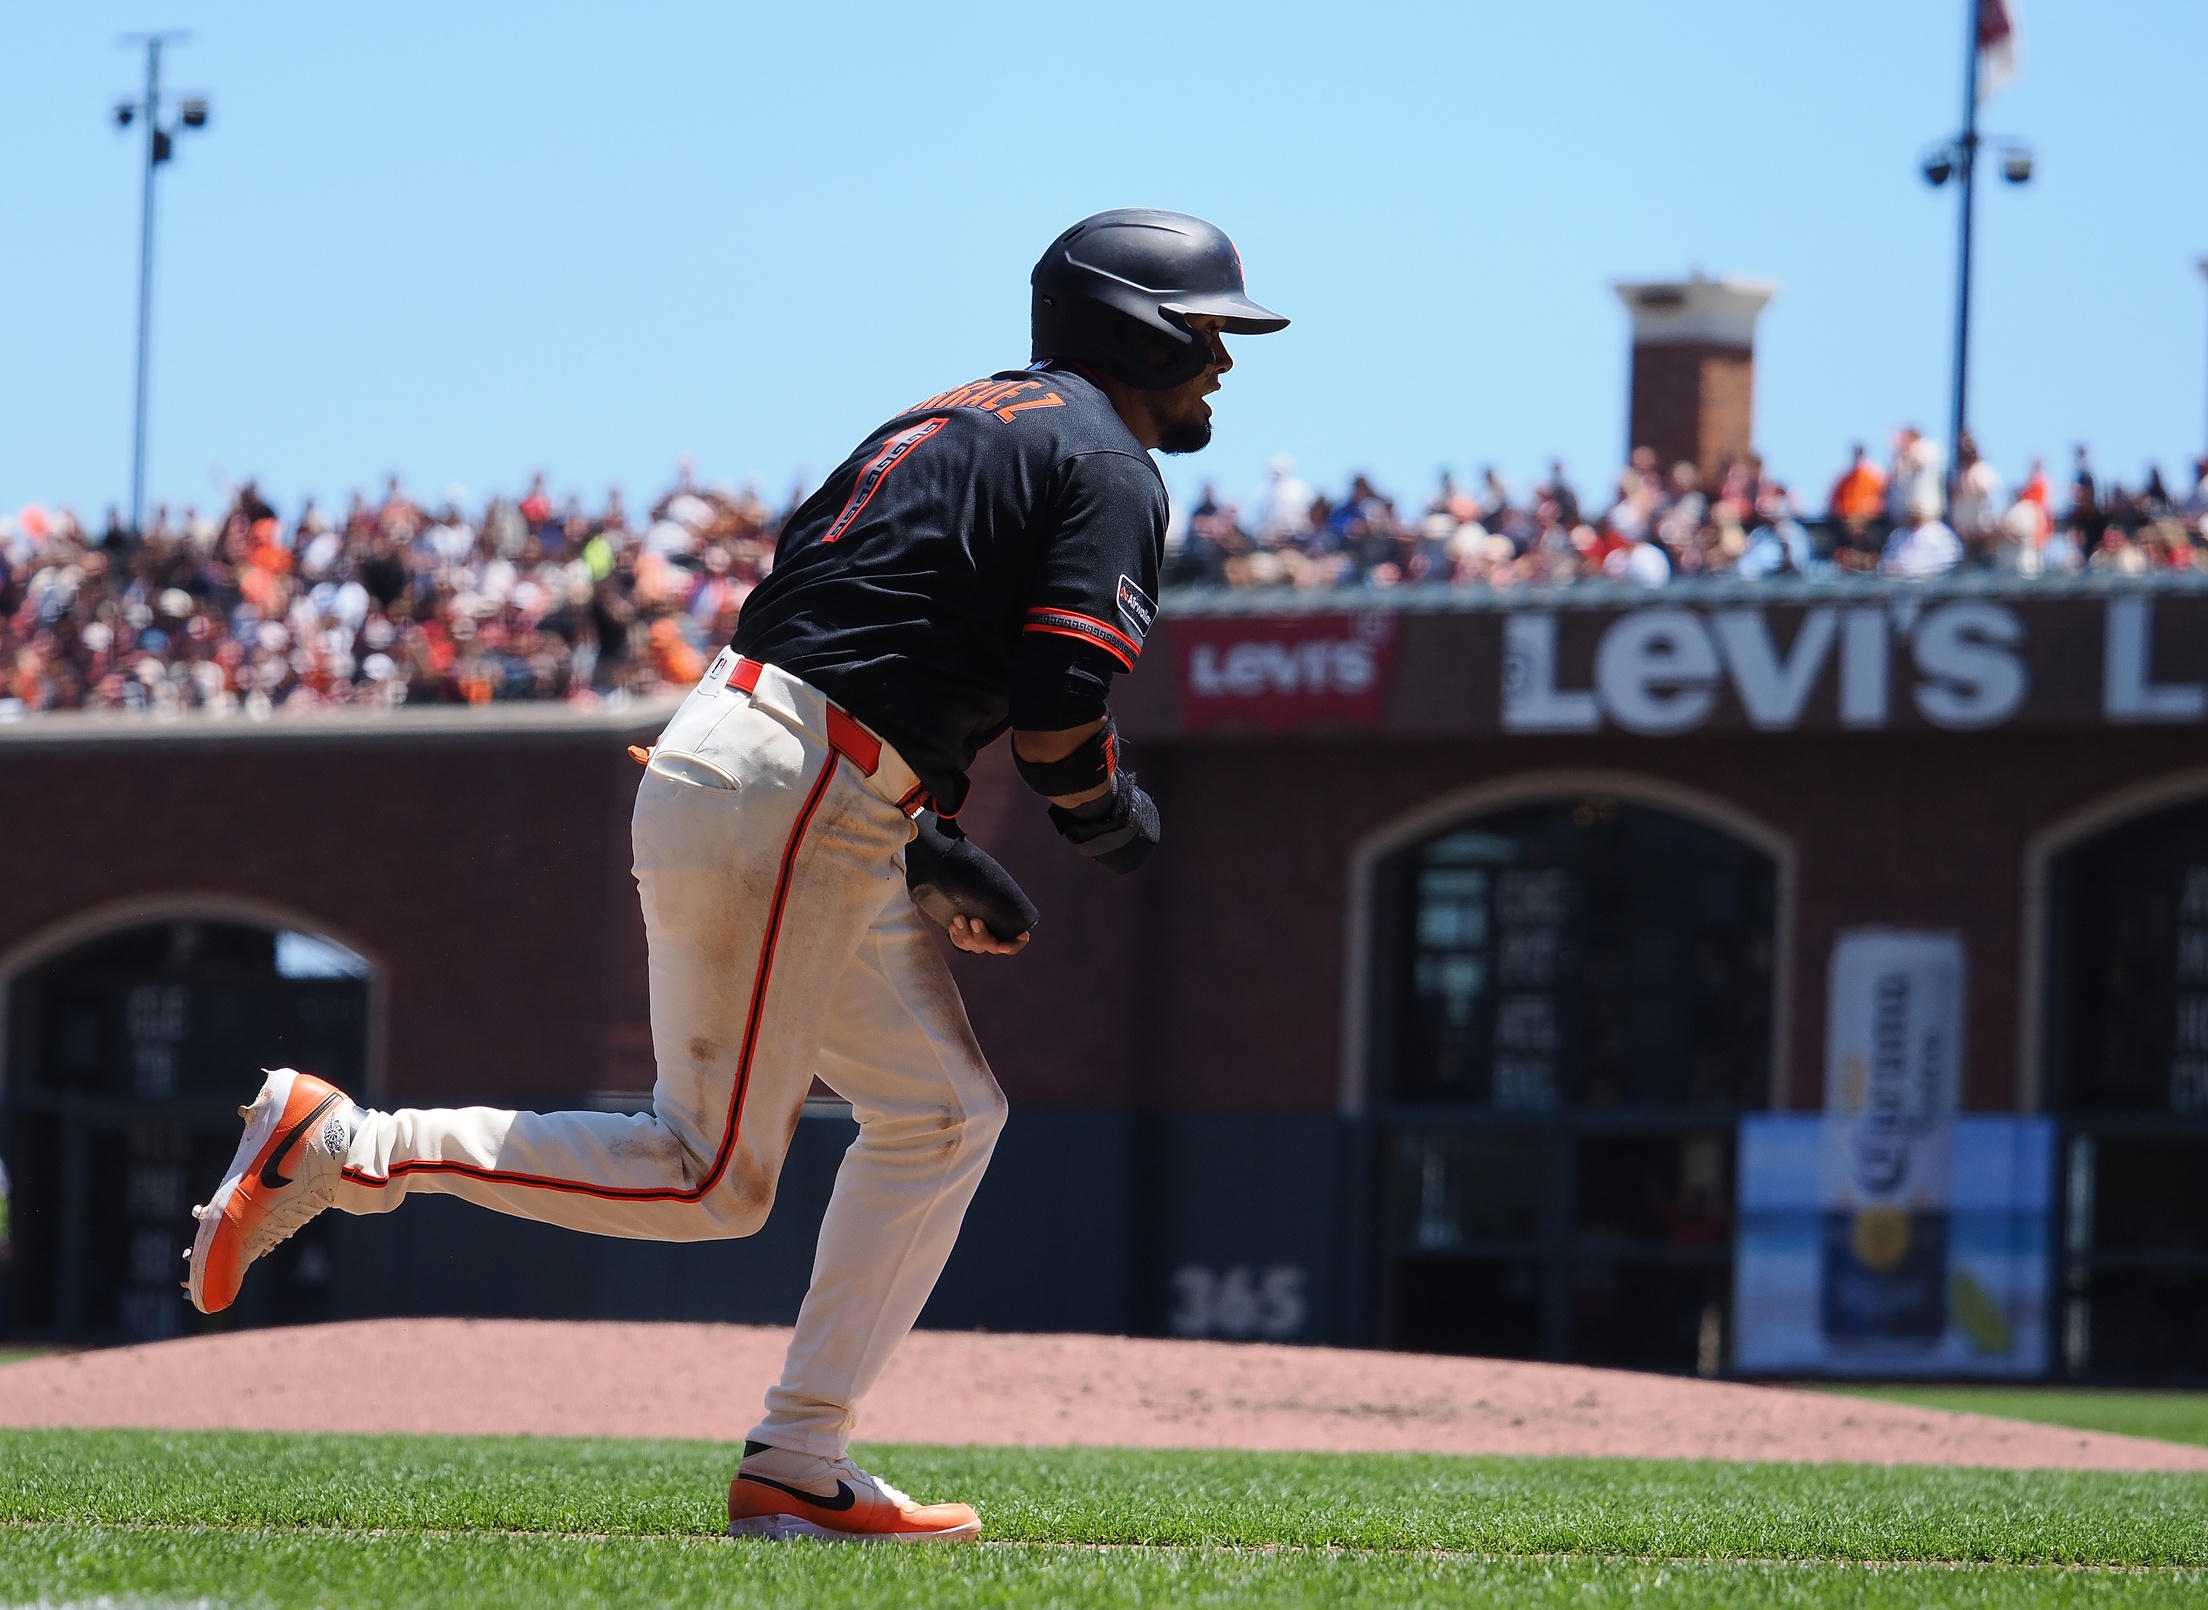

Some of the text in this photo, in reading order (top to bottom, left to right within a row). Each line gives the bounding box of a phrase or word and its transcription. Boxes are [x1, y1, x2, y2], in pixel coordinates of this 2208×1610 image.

[897, 381, 1066, 425] RRAEZ
[821, 417, 949, 542] 1
[1169, 1264, 1305, 1334] 365
